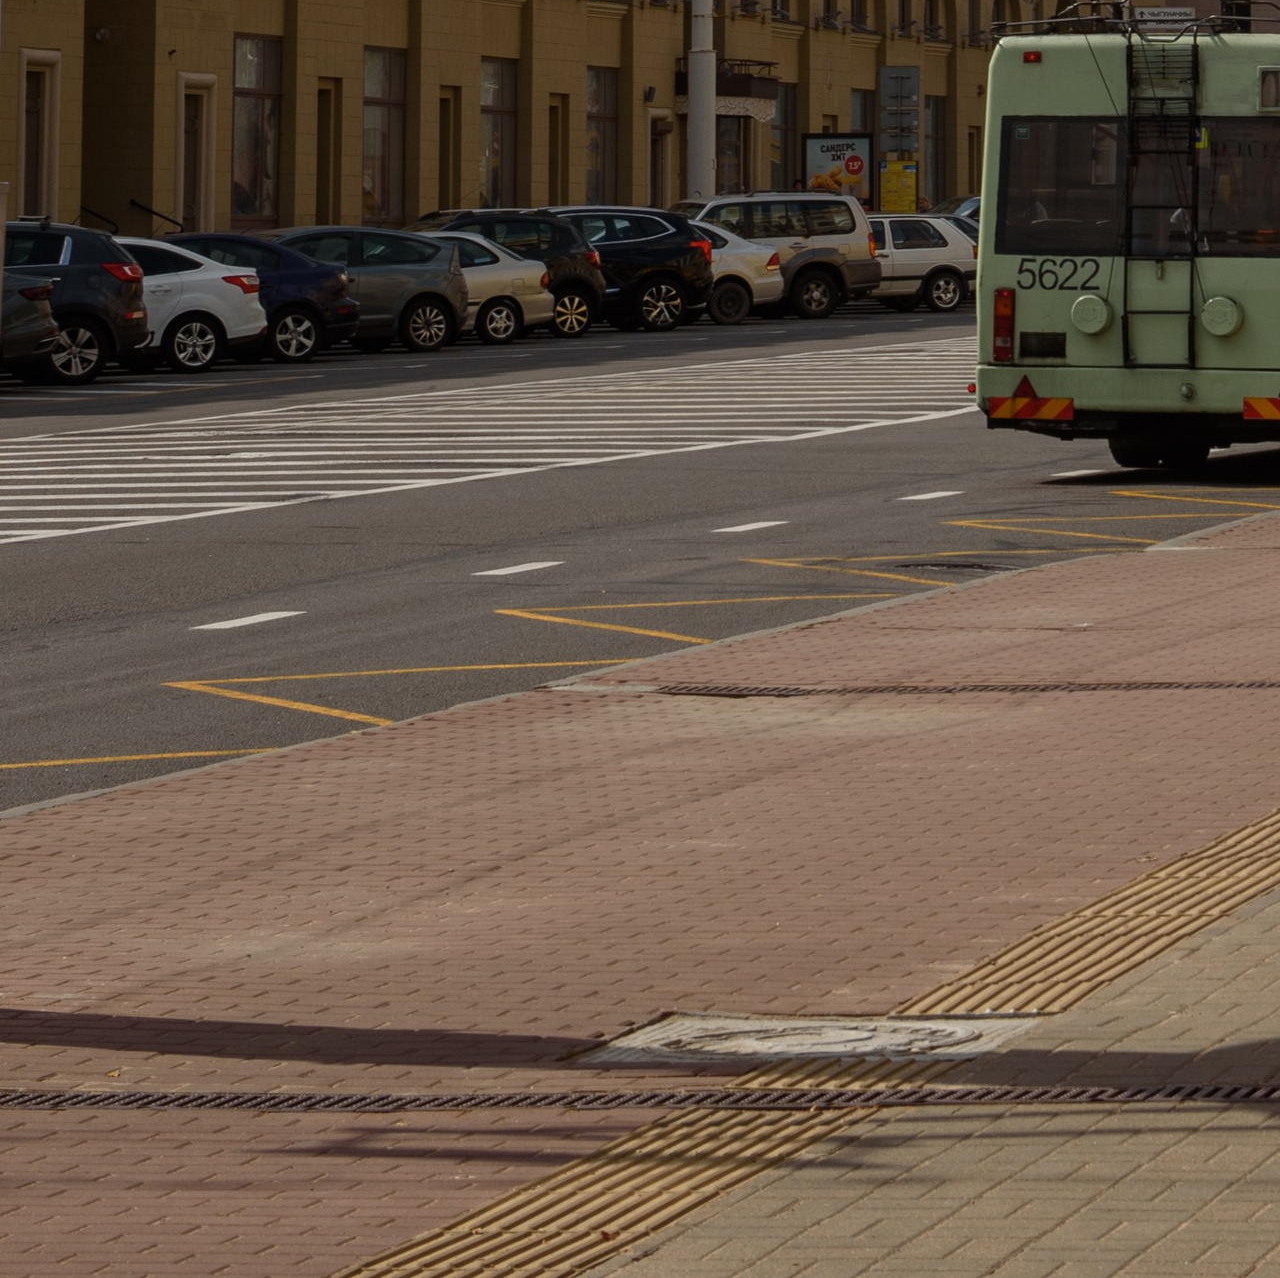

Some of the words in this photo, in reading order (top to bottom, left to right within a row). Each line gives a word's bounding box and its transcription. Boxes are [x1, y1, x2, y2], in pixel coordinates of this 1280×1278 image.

[820, 143, 856, 153] САНДЕРС
[830, 153, 847, 162] ХИТ
[1016, 257, 1101, 291] 5622
